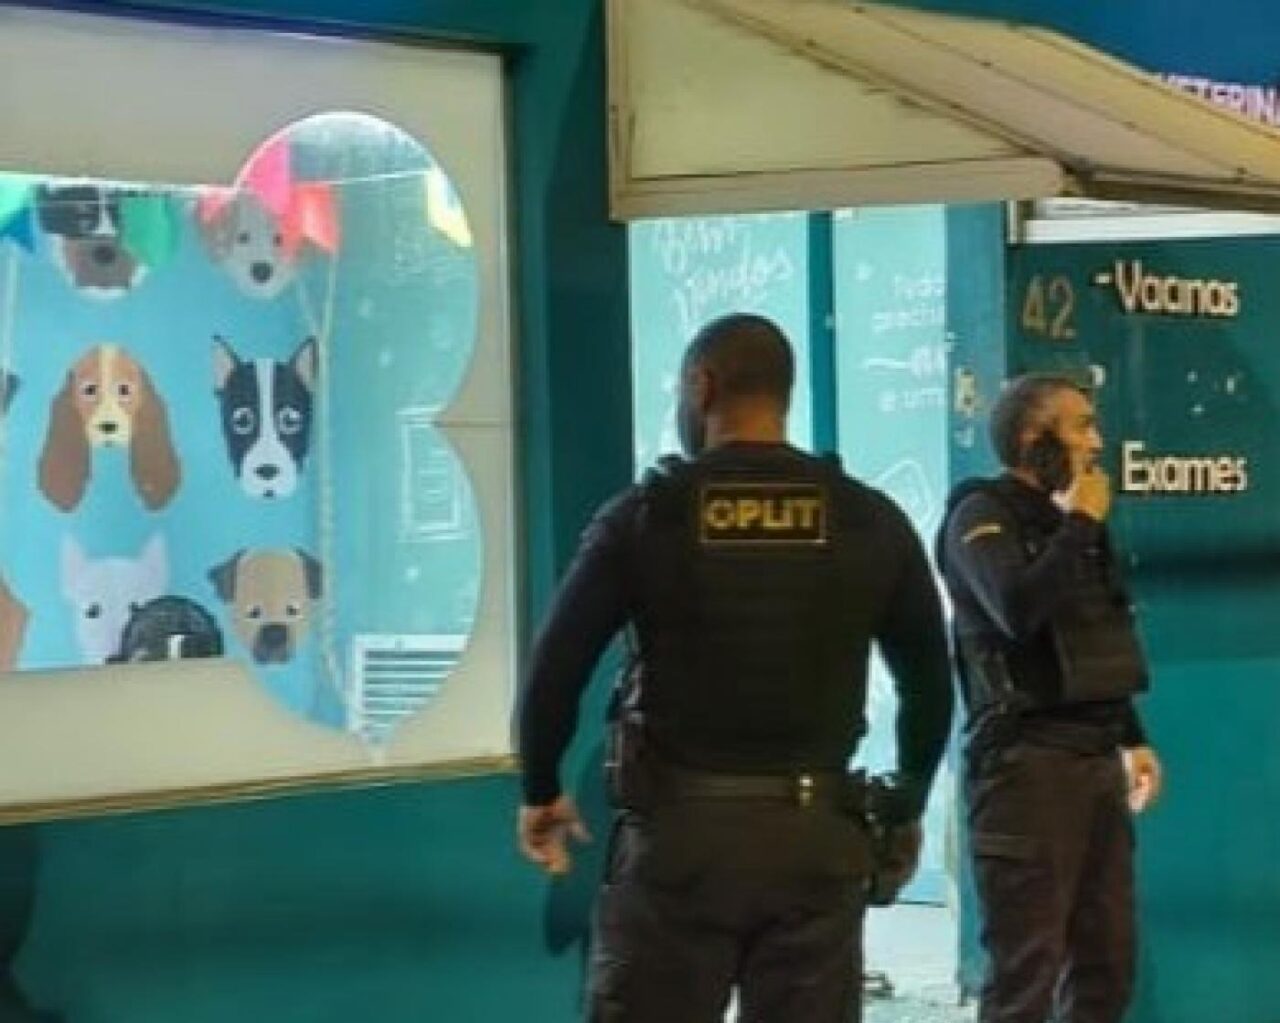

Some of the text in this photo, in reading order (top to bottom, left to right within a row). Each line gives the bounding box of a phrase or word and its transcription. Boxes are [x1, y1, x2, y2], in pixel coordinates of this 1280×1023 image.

[1022, 273, 1077, 338] 42
[1121, 440, 1248, 492] Exames
[705, 498, 822, 530] OPLIT
